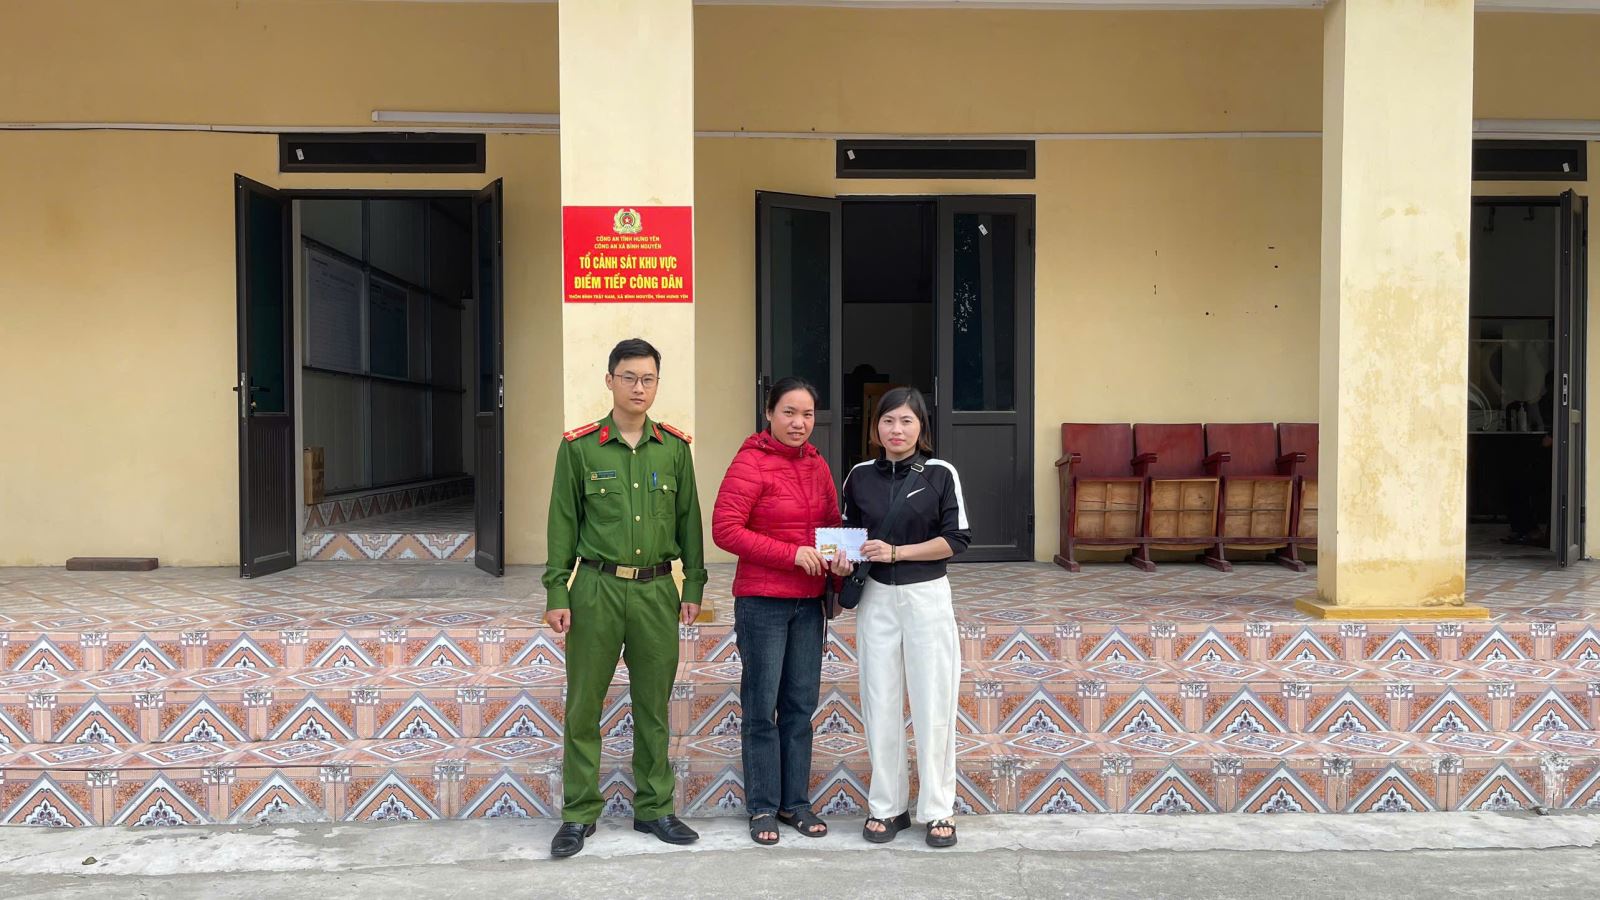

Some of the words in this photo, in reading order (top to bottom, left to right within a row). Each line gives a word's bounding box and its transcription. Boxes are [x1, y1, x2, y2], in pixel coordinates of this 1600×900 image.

[579, 252, 591, 269] TỔ
[593, 252, 618, 269] CẢNH
[620, 254, 637, 269] SÁT
[640, 256, 657, 269] KHU
[660, 256, 677, 272] VỰC
[574, 272, 601, 288] ĐIỂM
[604, 272, 626, 288] TIẾP
[630, 274, 658, 288] CÔNG
[662, 274, 682, 288] DÂN
